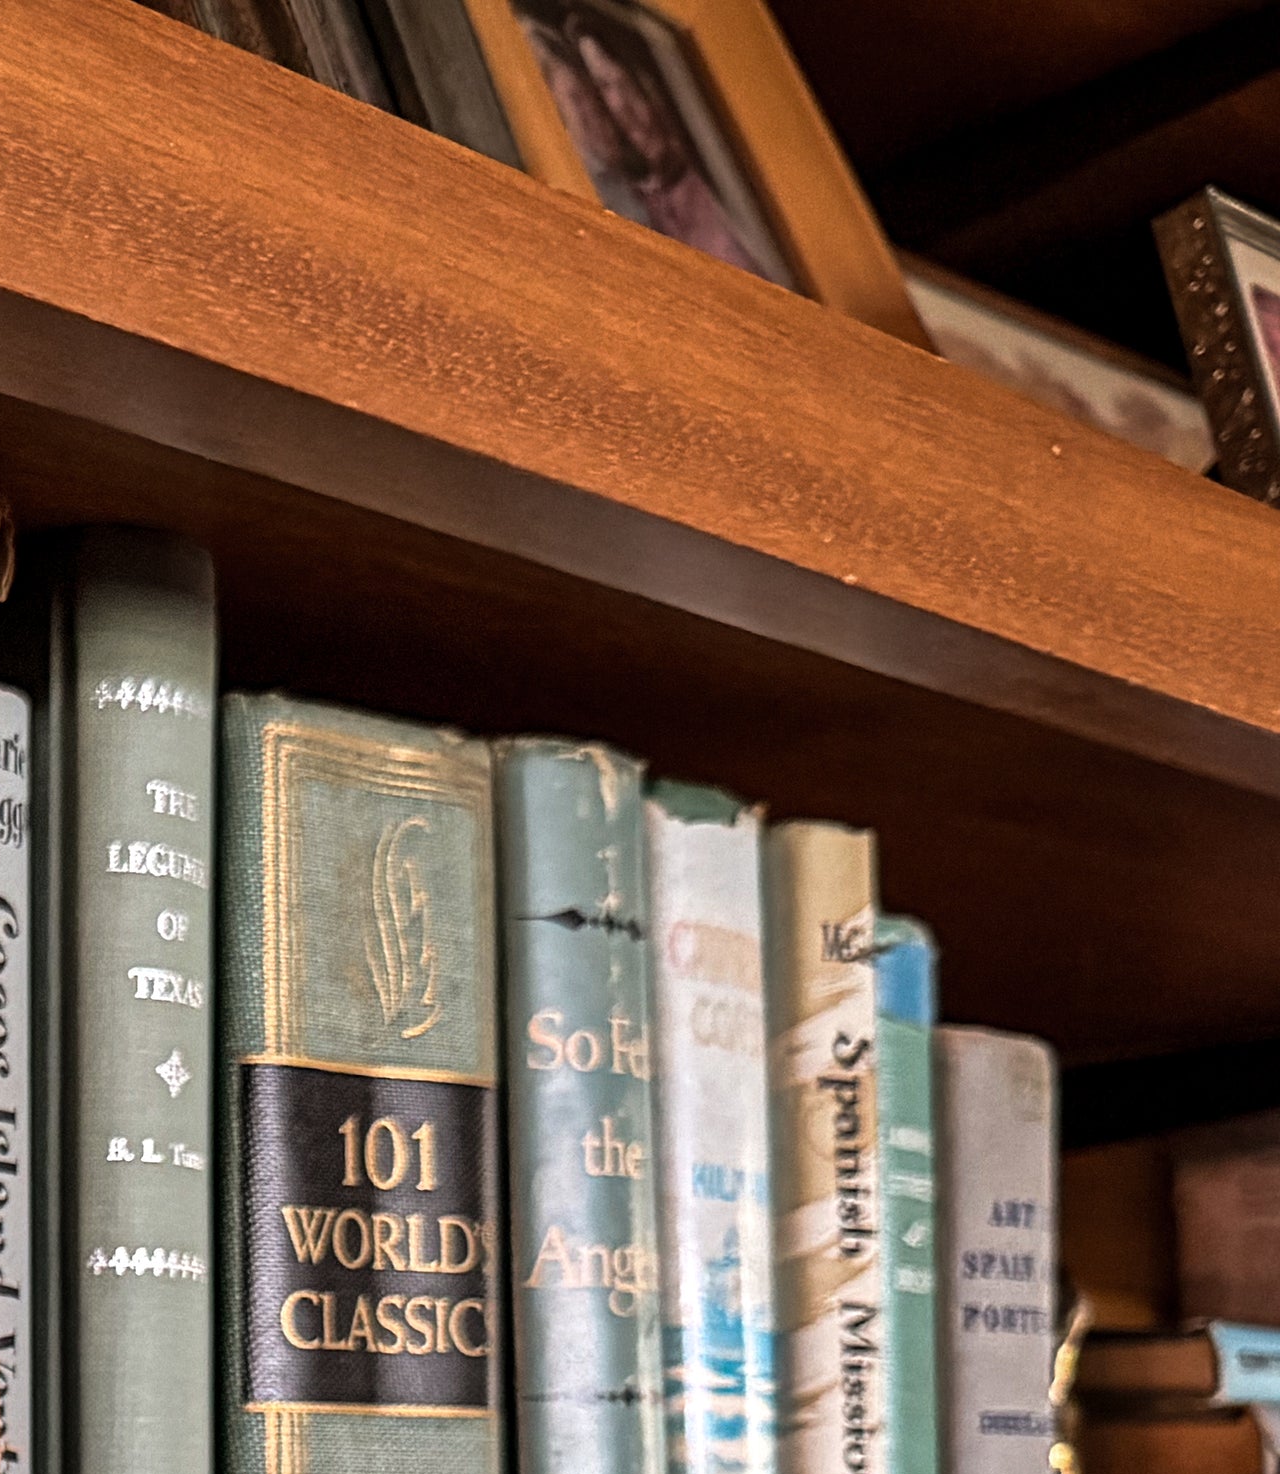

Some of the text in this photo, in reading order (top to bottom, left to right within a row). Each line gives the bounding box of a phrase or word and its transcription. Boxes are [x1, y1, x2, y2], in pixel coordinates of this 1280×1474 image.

[156, 907, 189, 942] OF
[526, 1008, 604, 1073] So
[338, 1115, 439, 1192] 101
[582, 1115, 647, 1179] the
[817, 1029, 878, 1260] Spanish
